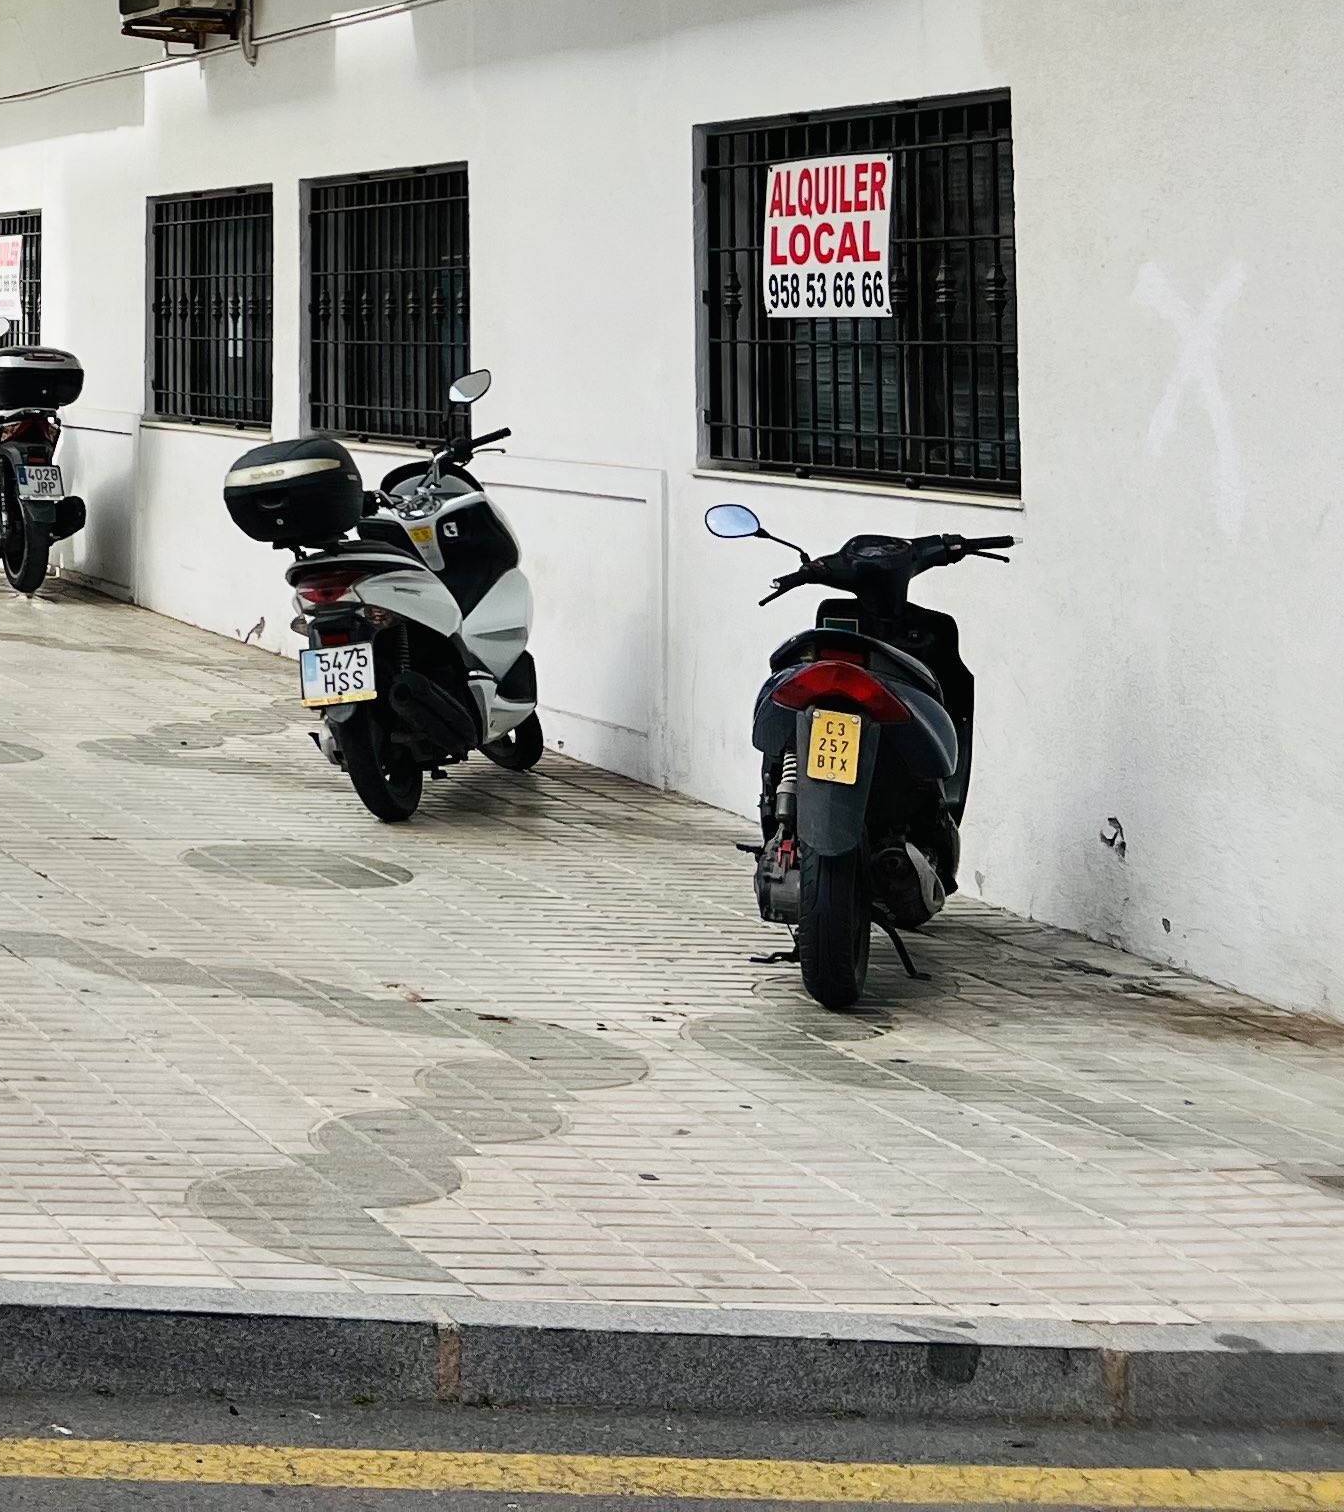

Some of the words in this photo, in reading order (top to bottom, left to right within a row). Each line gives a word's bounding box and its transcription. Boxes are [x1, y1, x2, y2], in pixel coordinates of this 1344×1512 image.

[768, 161, 887, 219] ALQUILER
[770, 220, 881, 266] LOCAL
[768, 273, 800, 309] 958
[805, 272, 827, 308] 53
[833, 271, 856, 308] 66
[861, 270, 884, 308] 66
[28, 468, 58, 481] 4028
[33, 481, 56, 494] JRP
[315, 647, 368, 673] 5475
[324, 670, 364, 694] HSS
[818, 737, 849, 754] 257
[817, 754, 848, 773] BTX
